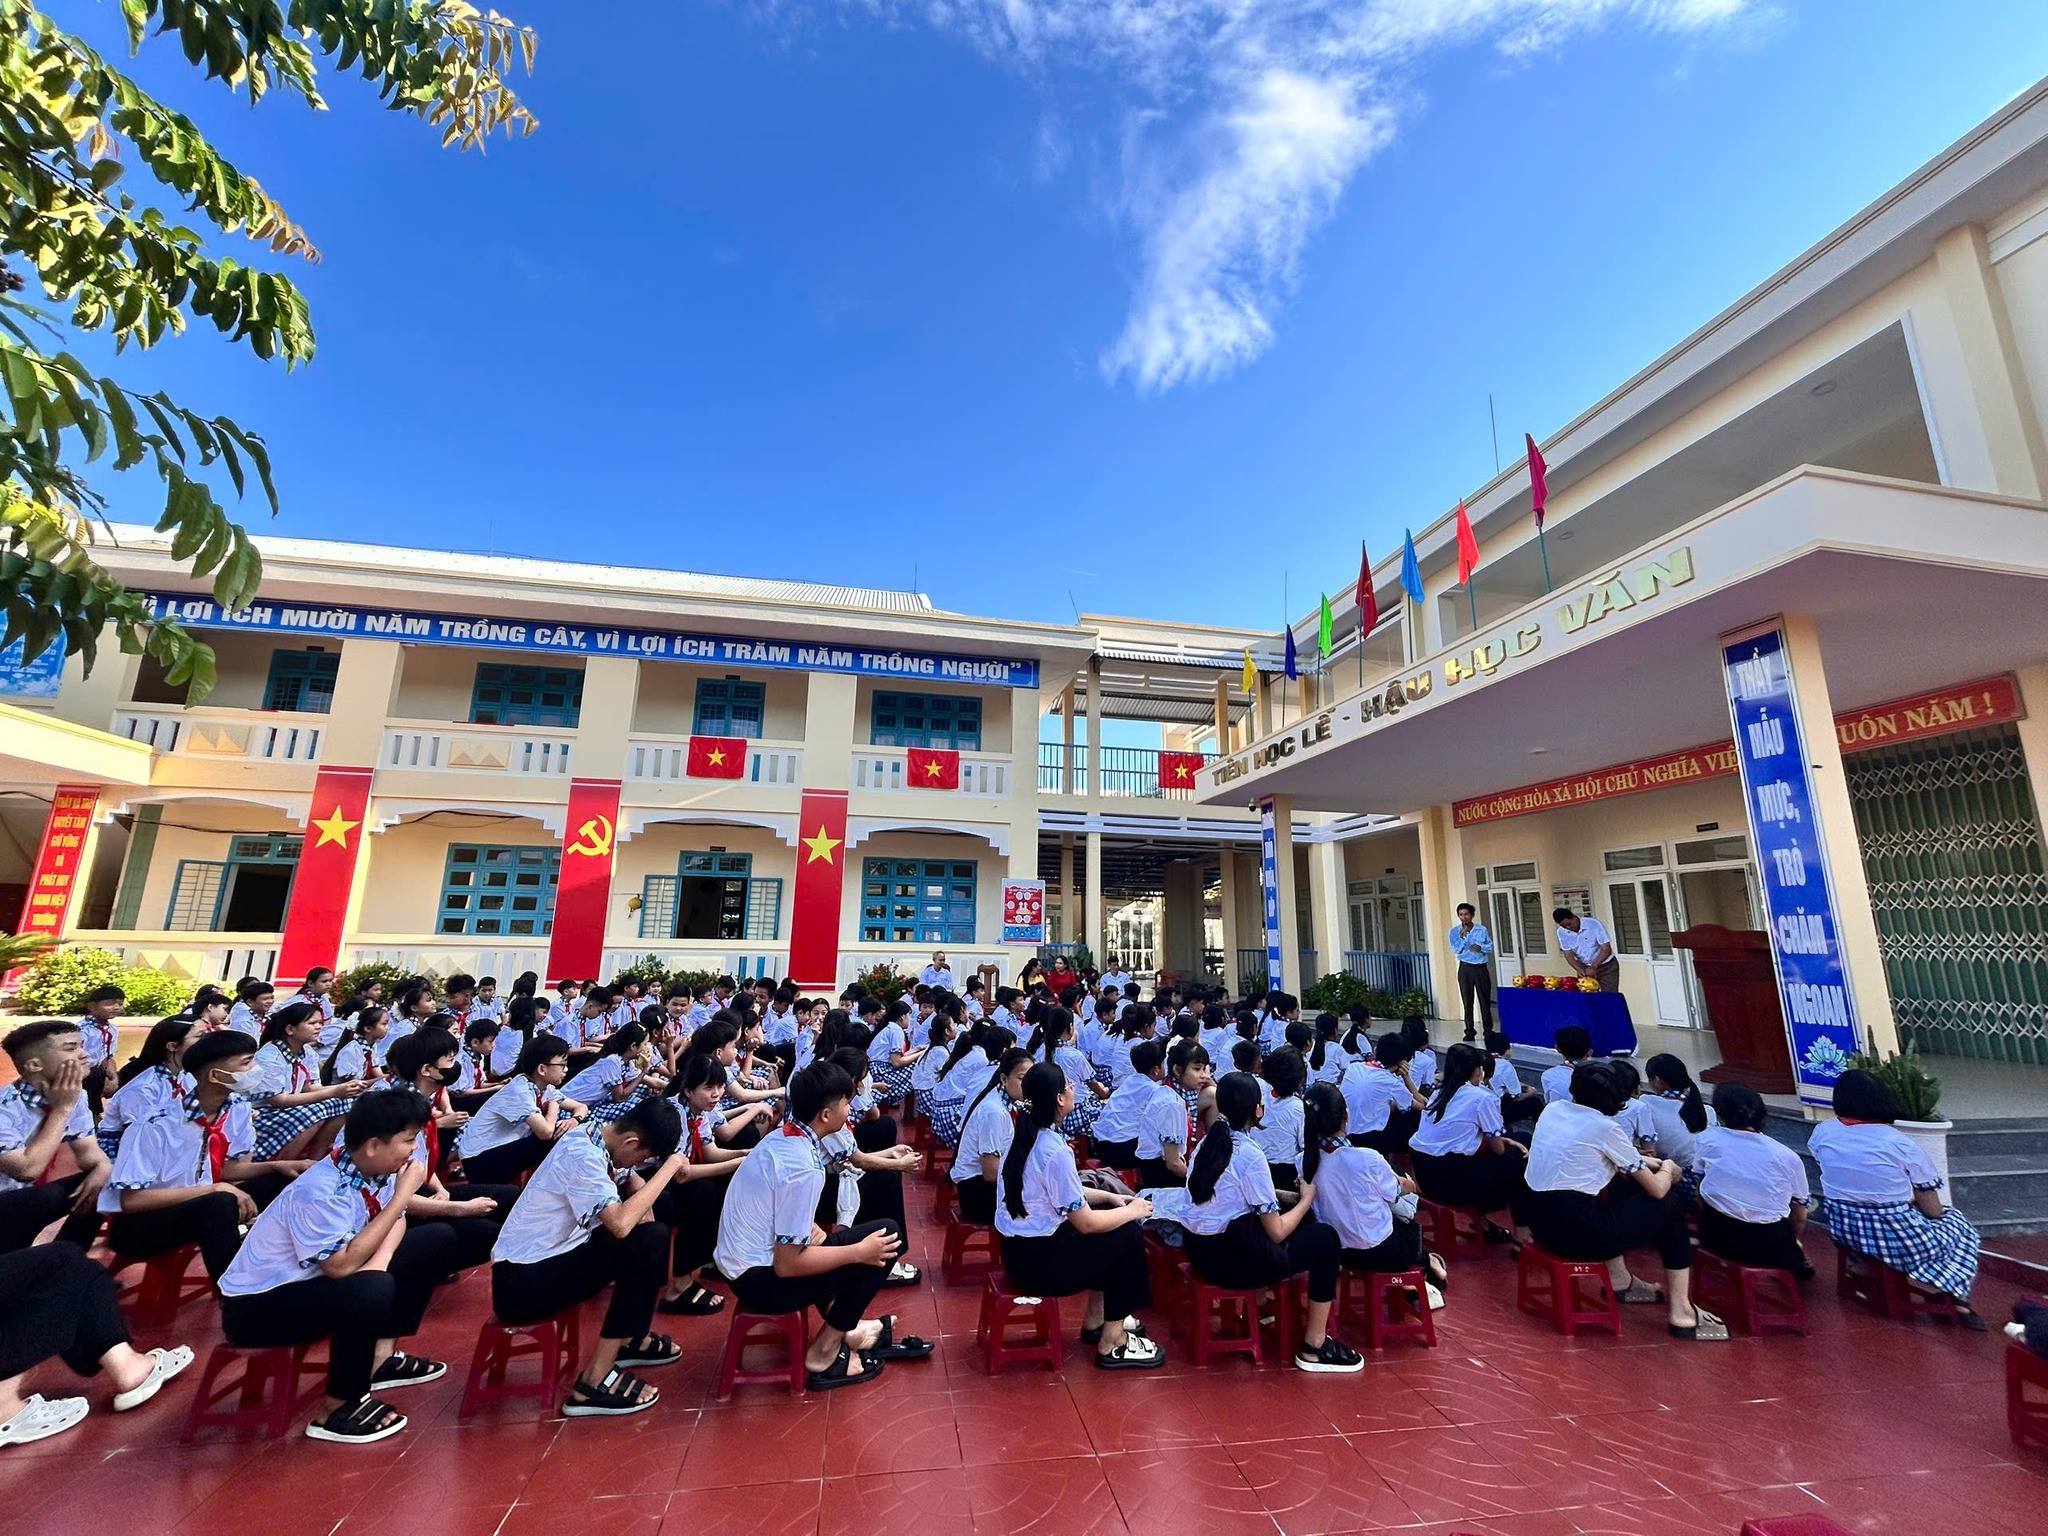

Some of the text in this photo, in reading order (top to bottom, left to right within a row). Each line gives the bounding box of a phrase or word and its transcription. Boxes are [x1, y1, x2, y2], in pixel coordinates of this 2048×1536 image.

[165, 600, 214, 622] LỢI
[280, 608, 356, 631] MƯỜI
[364, 613, 431, 636] NĂM
[439, 618, 526, 643] TRỒNG
[533, 626, 587, 650] CÂY,
[596, 631, 620, 650] VÌ
[627, 634, 666, 656] LỢI
[673, 635, 715, 657] ÍCH
[722, 641, 791, 664] TRĂM
[797, 647, 853, 668] NĂM
[859, 651, 935, 674] TRỒNG
[1211, 758, 1249, 786] TIÊN
[1253, 736, 1296, 769] HỌC
[1360, 670, 1433, 723] HẬU
[1444, 622, 1542, 687] HỌC
[1556, 546, 1695, 634] VĂN
[1458, 802, 1488, 822] NƯỚC
[1490, 797, 1522, 817] CỘNG
[1523, 788, 1552, 809] HÒA
[1552, 782, 1572, 802] XÃ
[1574, 776, 1603, 800] HỘI
[1605, 765, 1639, 793] CHỦ
[1642, 755, 1702, 785] NGHĨA
[1704, 744, 1738, 772] VIỆ
[1835, 713, 1897, 745] UÔN
[1903, 696, 1977, 732] NĂM
[1772, 838, 1807, 887] TRÒ
[1778, 906, 1828, 955] CHĂM
[1788, 983, 1849, 1027] NGOAN
